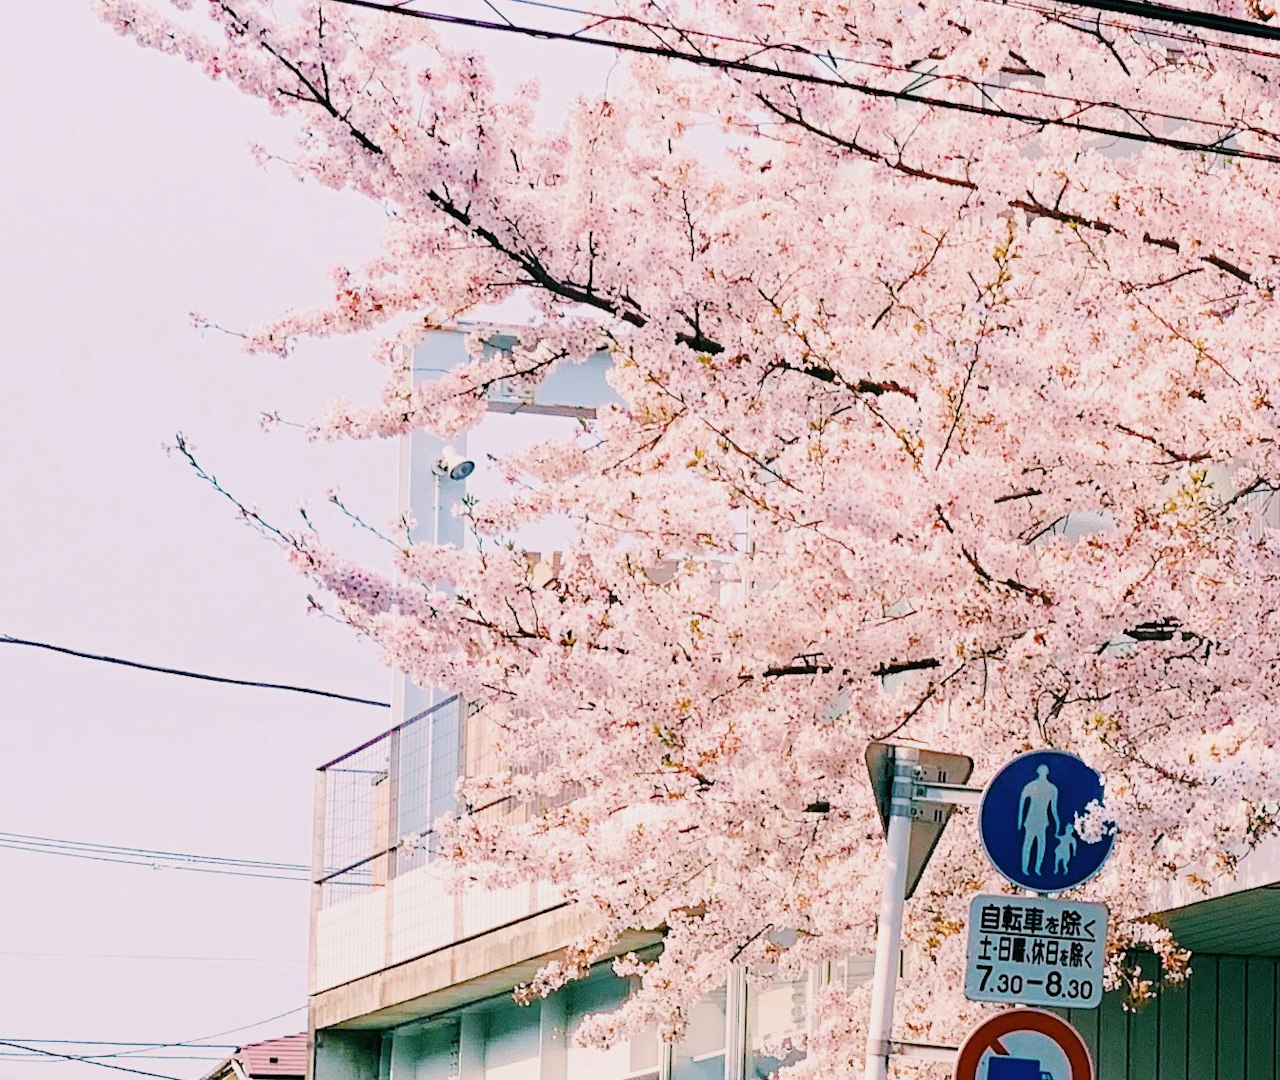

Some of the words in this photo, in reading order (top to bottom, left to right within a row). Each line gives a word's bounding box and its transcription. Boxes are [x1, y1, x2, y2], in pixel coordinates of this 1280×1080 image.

[980, 903, 1096, 938] 自転車を除く
